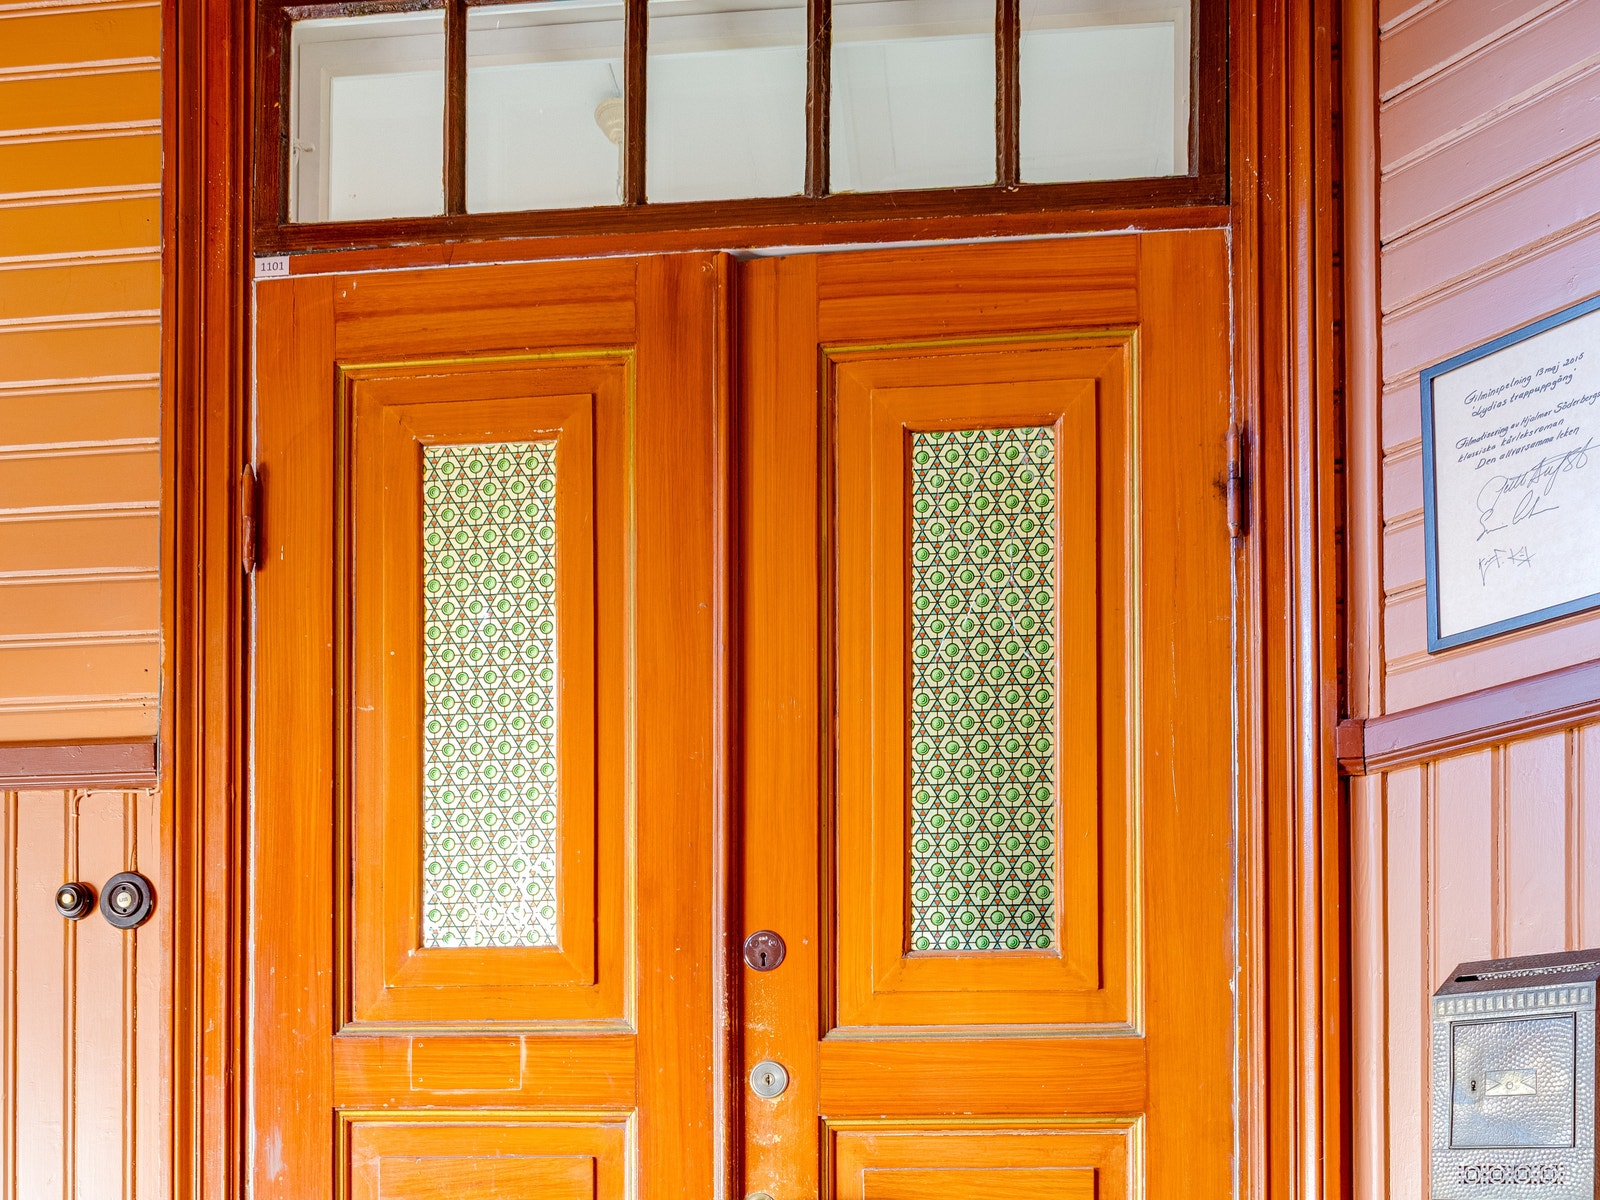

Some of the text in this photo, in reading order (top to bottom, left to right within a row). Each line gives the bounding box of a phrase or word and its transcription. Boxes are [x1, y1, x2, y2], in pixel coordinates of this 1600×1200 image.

[261, 261, 284, 271] 1101
[1463, 352, 1585, 405] Filminspelning 13 maj 2015
[1458, 444, 1496, 463] klassiska
[1475, 427, 1580, 470] Den allvarsamma leken
